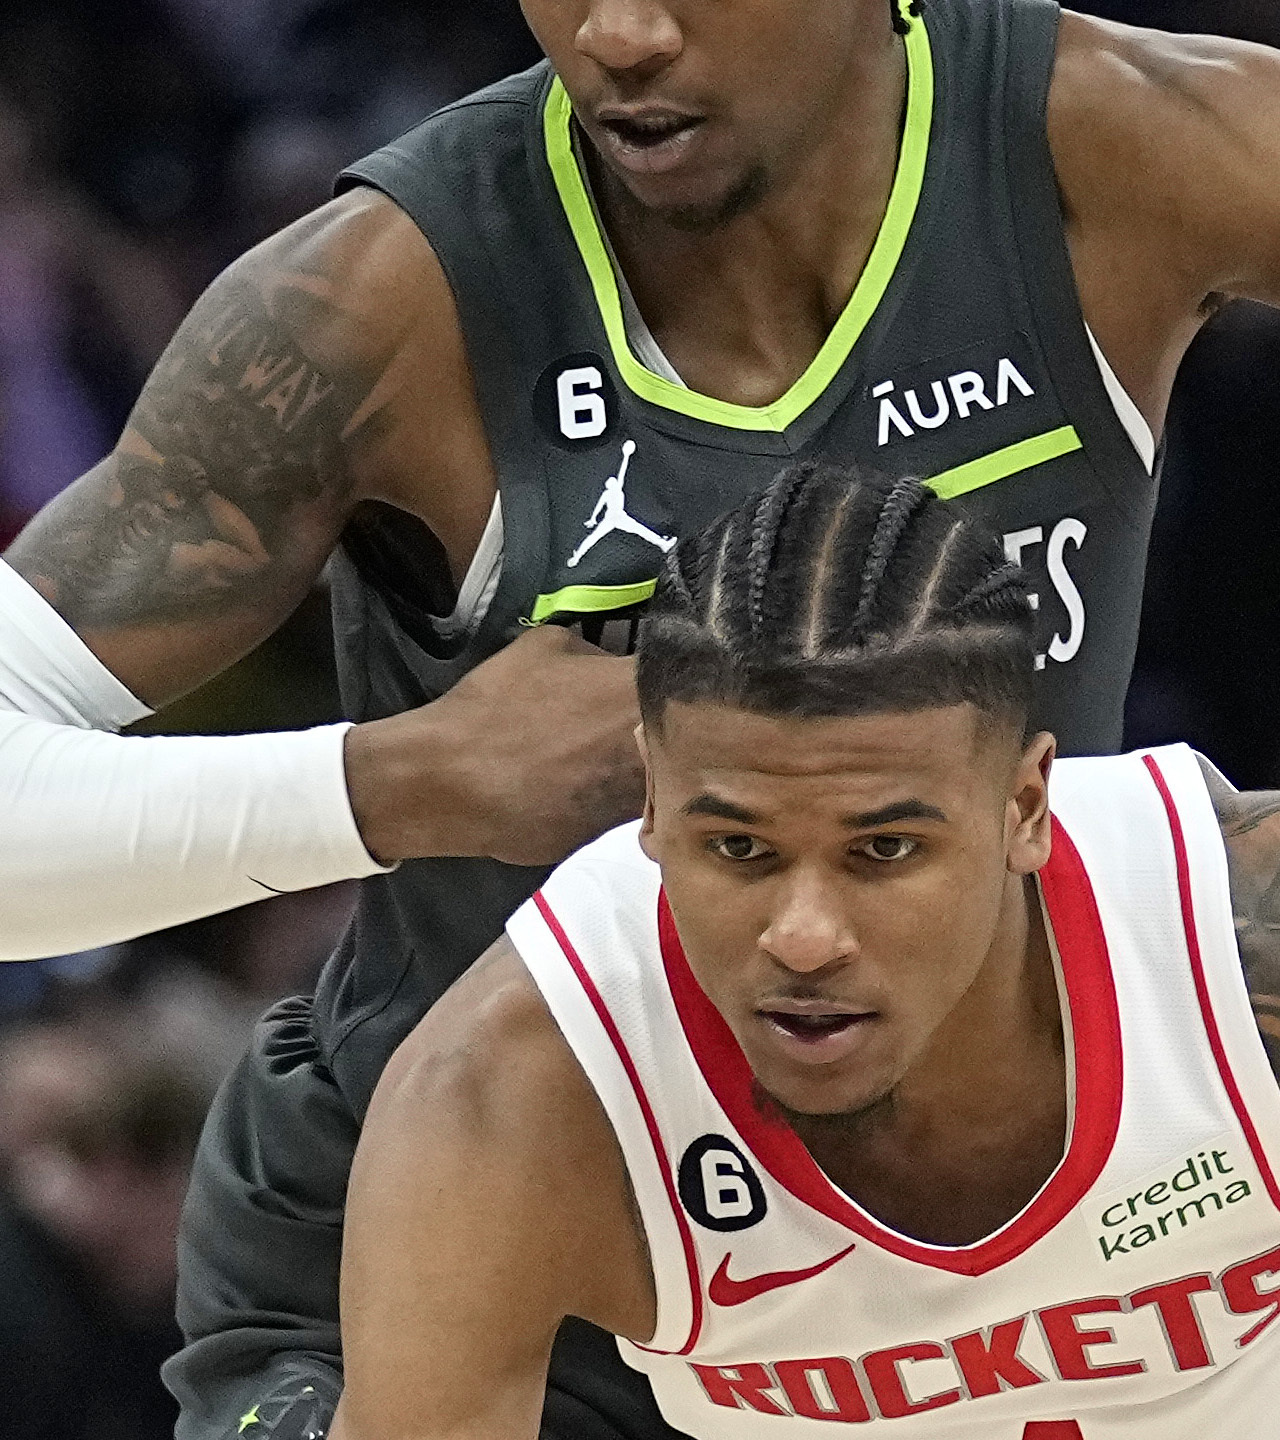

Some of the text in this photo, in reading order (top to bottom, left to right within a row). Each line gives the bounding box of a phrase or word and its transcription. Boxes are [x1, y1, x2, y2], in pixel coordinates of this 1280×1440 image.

[556, 365, 607, 440] 6
[700, 1148, 756, 1220] 6
[1096, 1176, 1253, 1262] karma
[1099, 1146, 1235, 1229] credit
